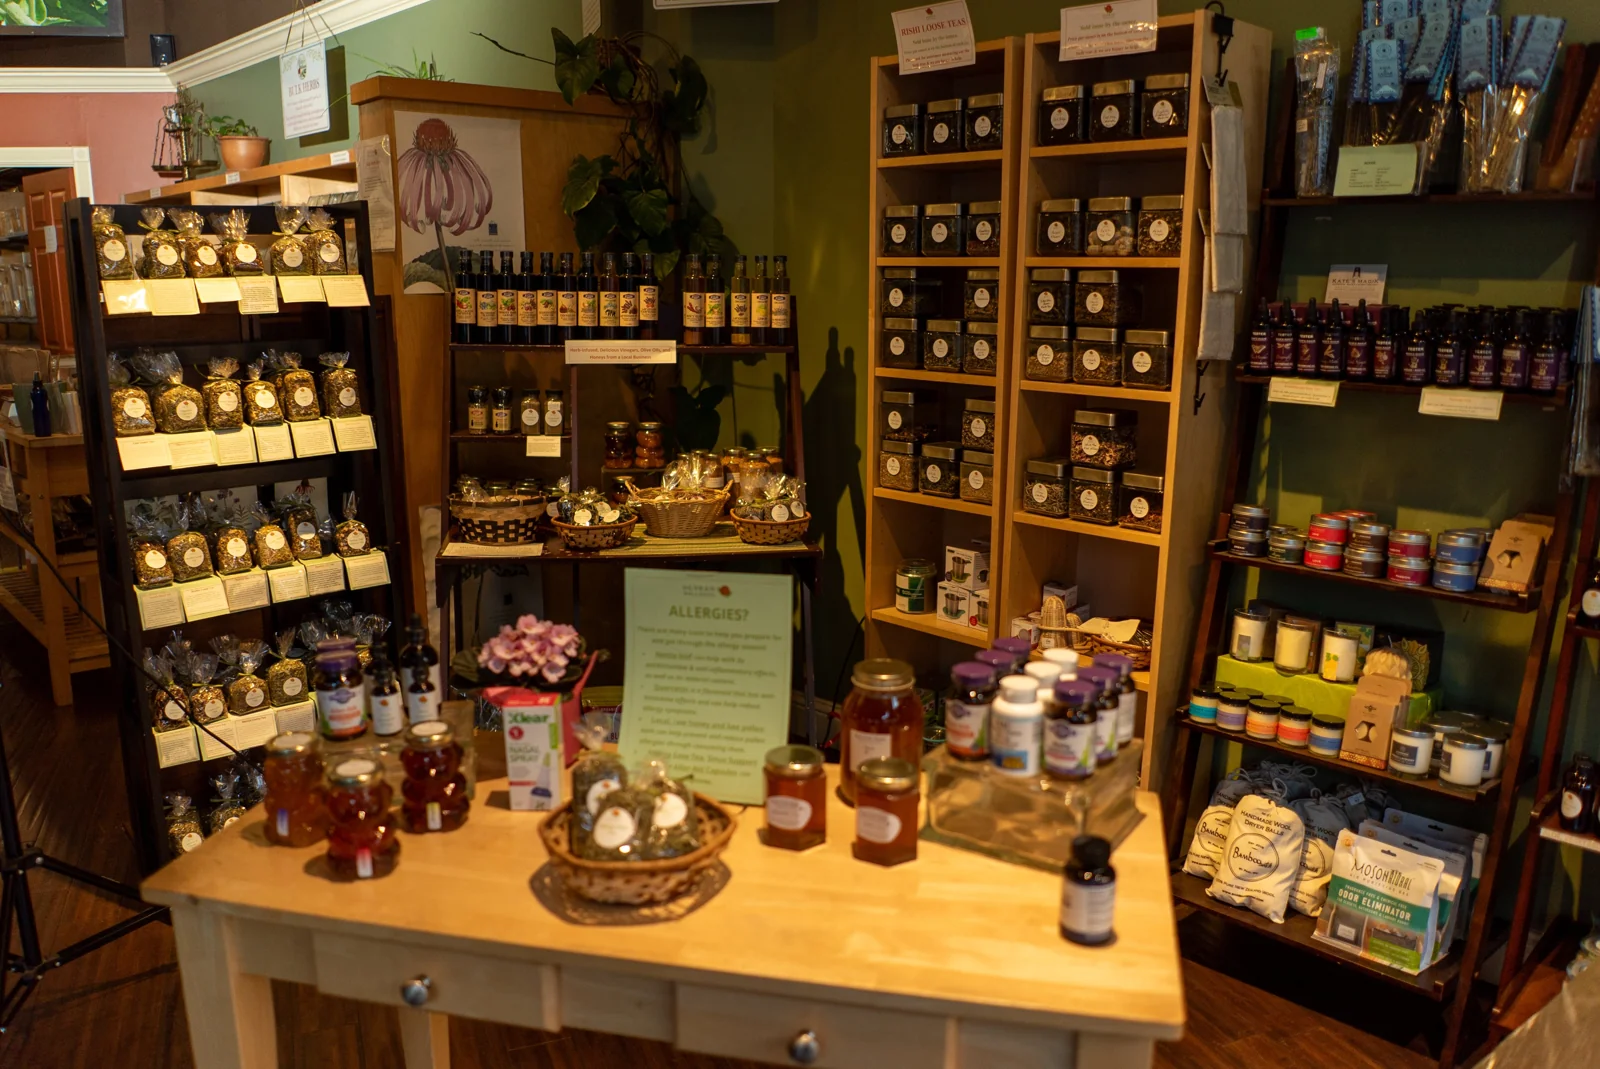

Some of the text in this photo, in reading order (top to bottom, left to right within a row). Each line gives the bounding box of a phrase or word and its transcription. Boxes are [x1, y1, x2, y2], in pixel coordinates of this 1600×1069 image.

[901, 18, 966, 36] RISHI LOOSE TEAS
[668, 605, 749, 621] ALLERGIES?
[1240, 810, 1292, 831] HANDMADE WOOL
[1244, 819, 1284, 837] DRYER BALLS
[1338, 888, 1411, 921] ODOR ELIMINATOR
